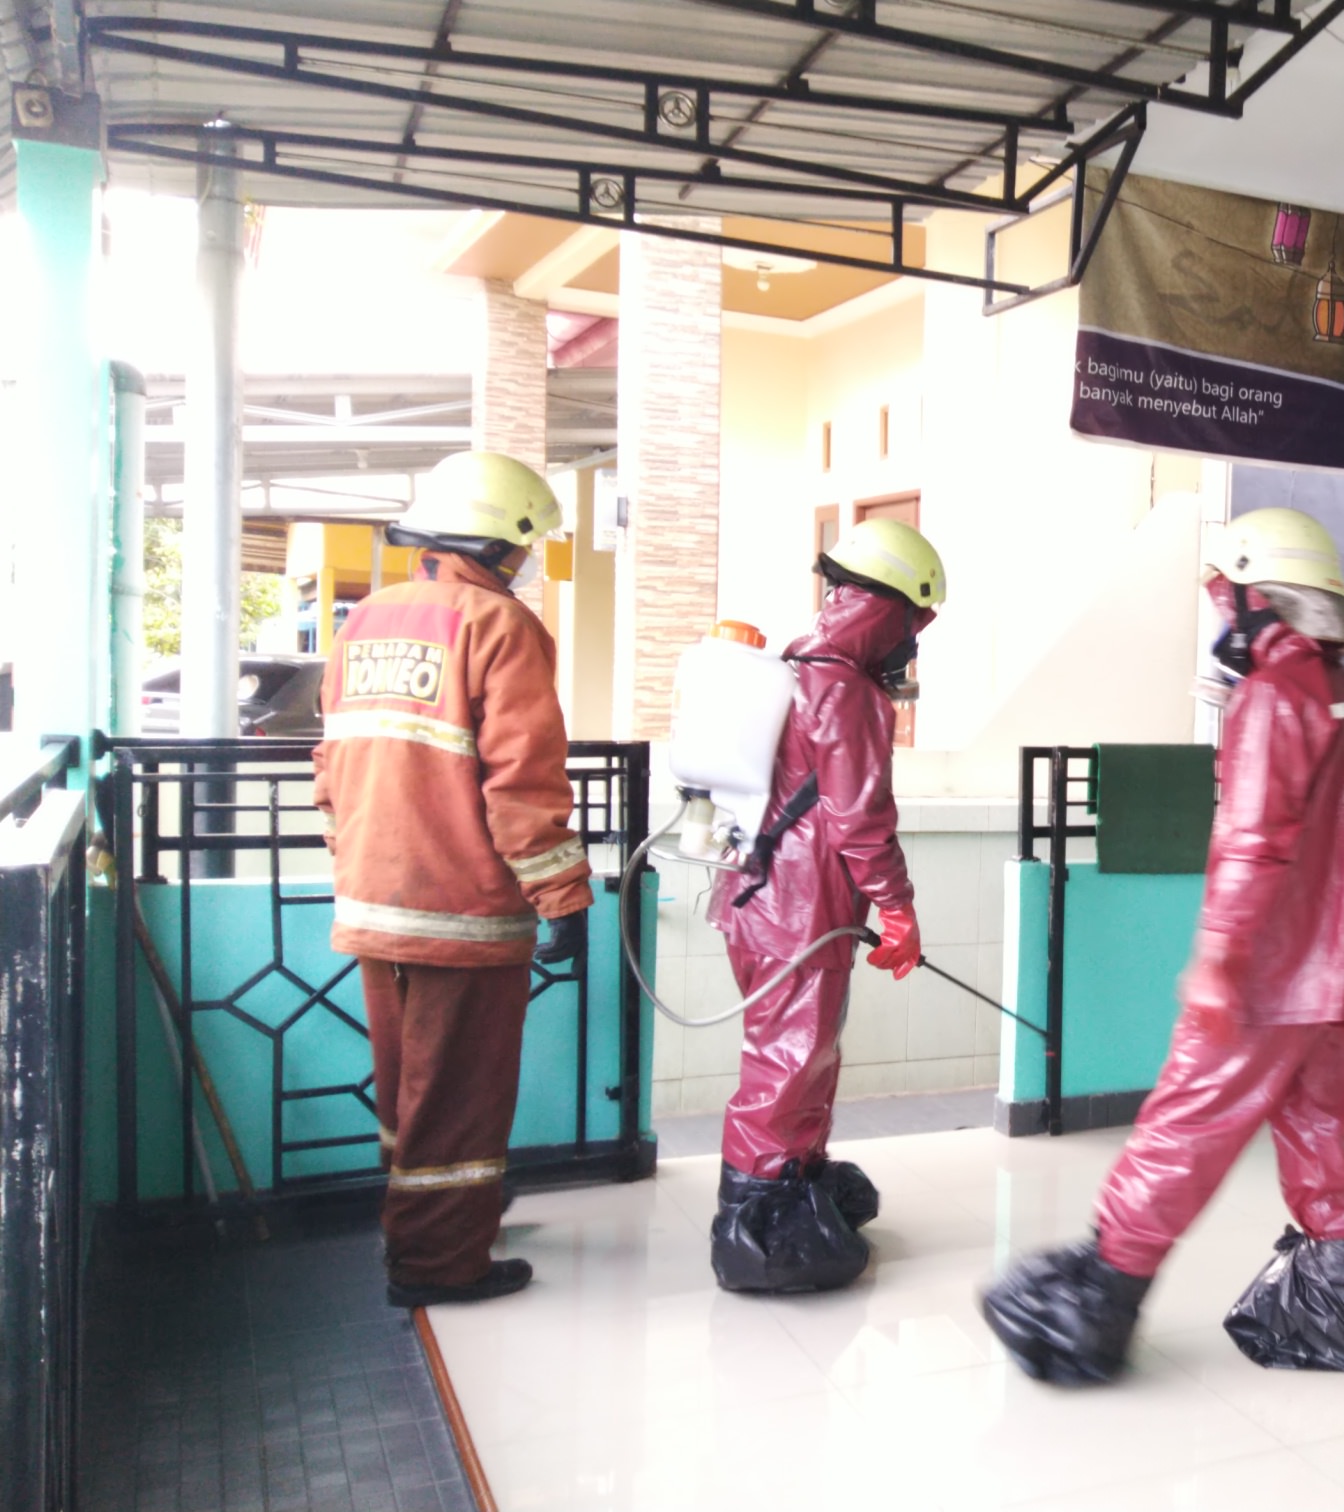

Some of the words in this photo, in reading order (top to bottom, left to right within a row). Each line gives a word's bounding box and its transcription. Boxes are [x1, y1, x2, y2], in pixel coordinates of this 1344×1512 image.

[1079, 382, 1133, 406] banyak
[1138, 395, 1217, 418] menyebut
[1087, 357, 1144, 383] bagimu
[1150, 370, 1198, 393] (yaitu)
[1202, 378, 1234, 402] bagi
[1238, 386, 1283, 408] orang
